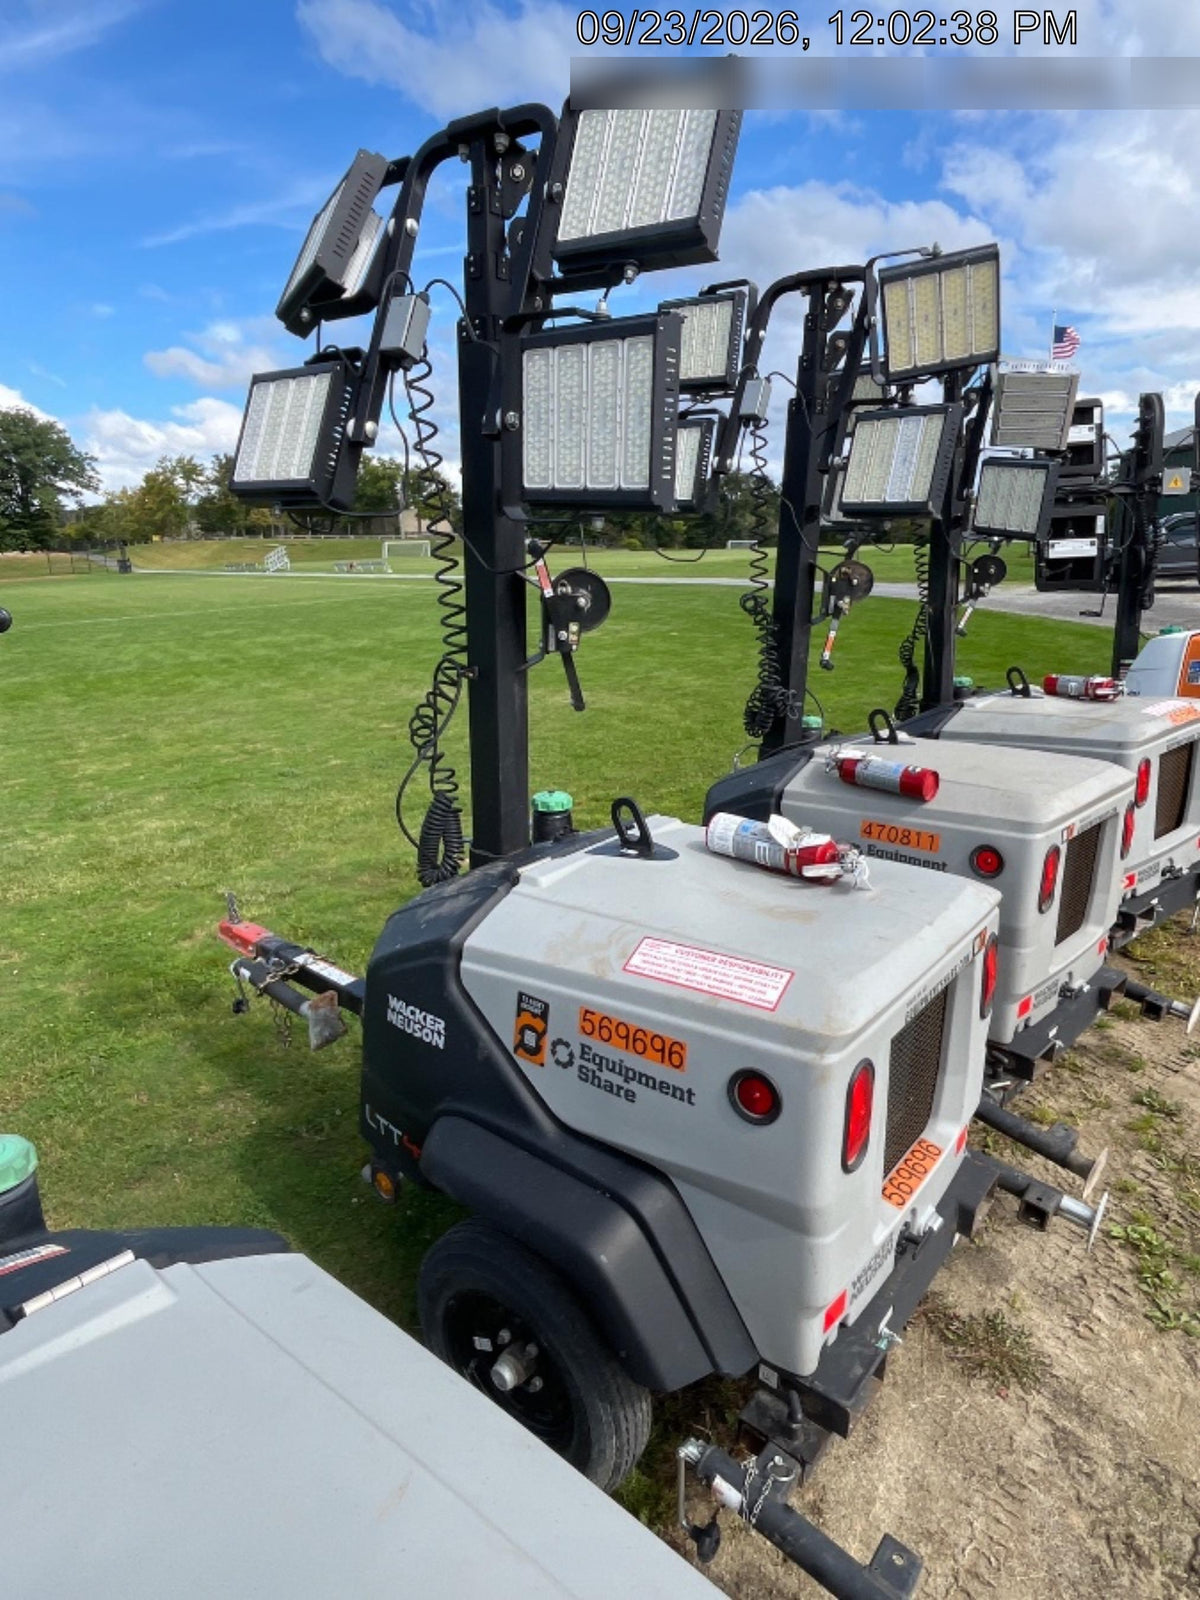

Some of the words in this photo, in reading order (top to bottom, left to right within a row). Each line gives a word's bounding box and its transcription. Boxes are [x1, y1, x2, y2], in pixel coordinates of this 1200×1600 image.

[863, 822, 935, 851] 470811
[387, 993, 445, 1035] WACKER
[387, 1008, 445, 1050] NEUSON
[581, 1009, 684, 1070] 569696
[577, 1064, 637, 1104] Share
[579, 1041, 697, 1107] Equipment
[882, 1138, 942, 1207] 569696
